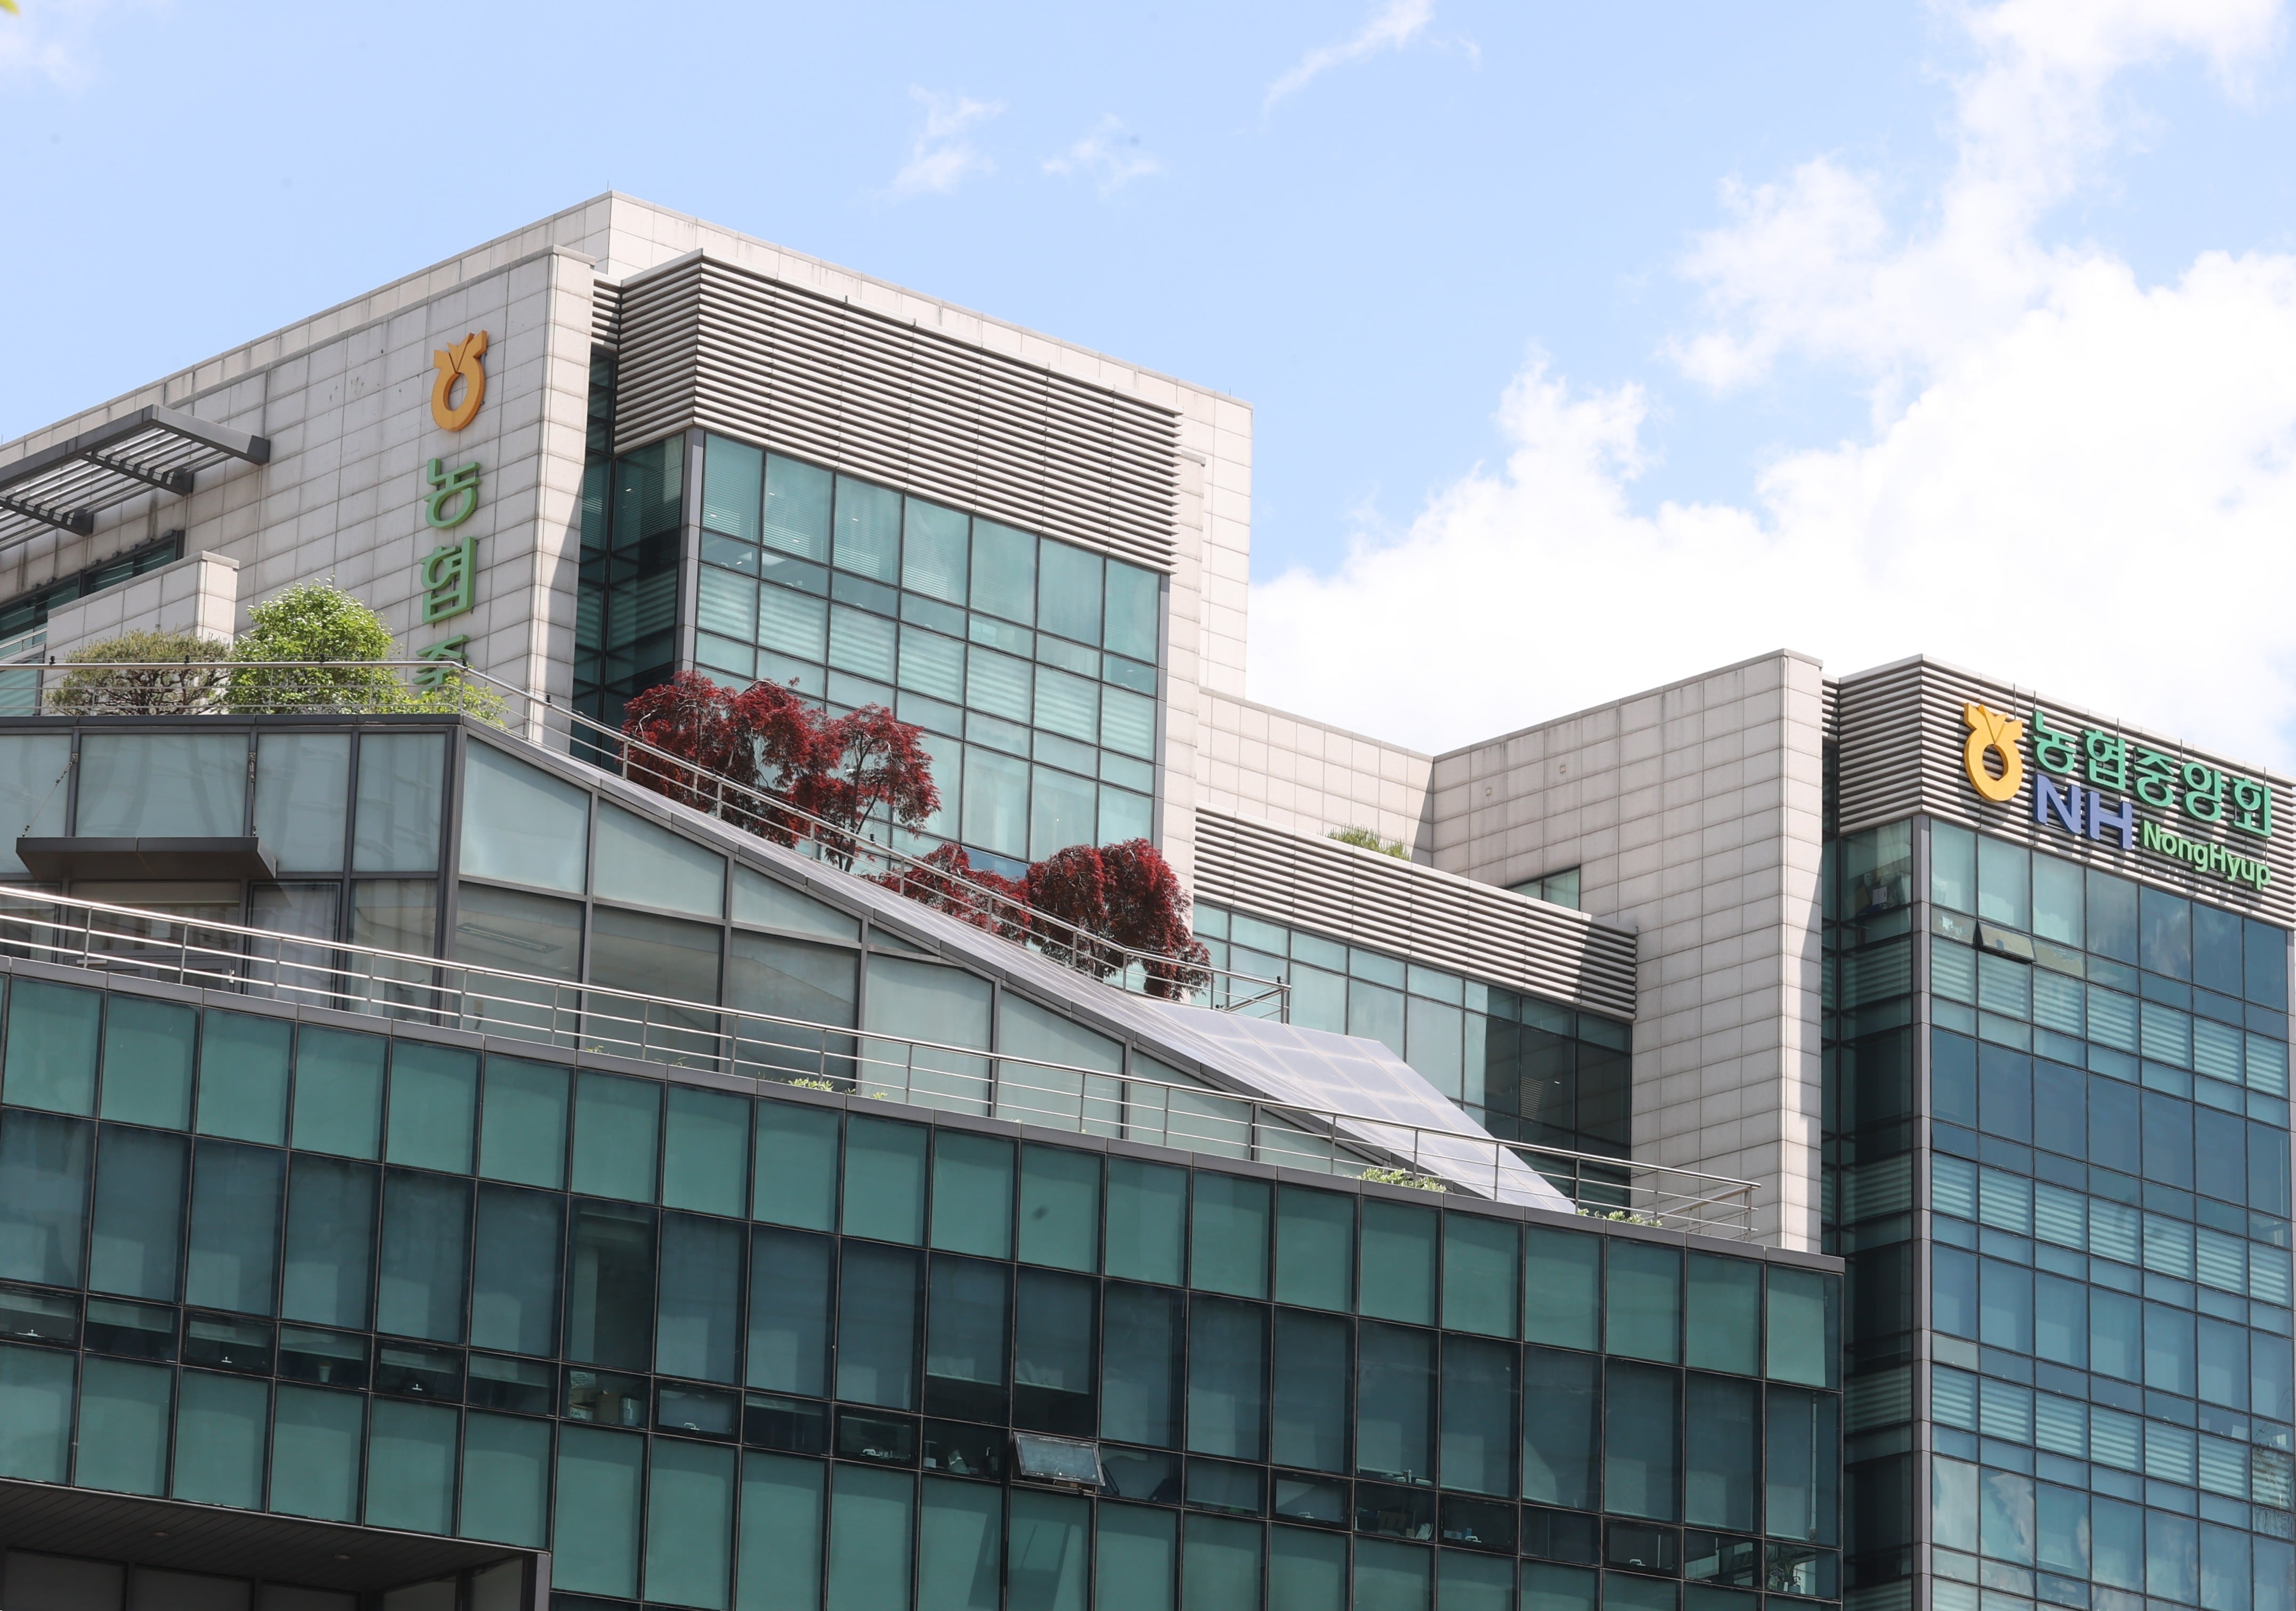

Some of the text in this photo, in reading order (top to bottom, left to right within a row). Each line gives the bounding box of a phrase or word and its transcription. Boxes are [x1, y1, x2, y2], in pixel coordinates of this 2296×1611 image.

[2031, 710, 2272, 838] 농협중앙회
[2033, 772, 2271, 891] NH NongHyup
